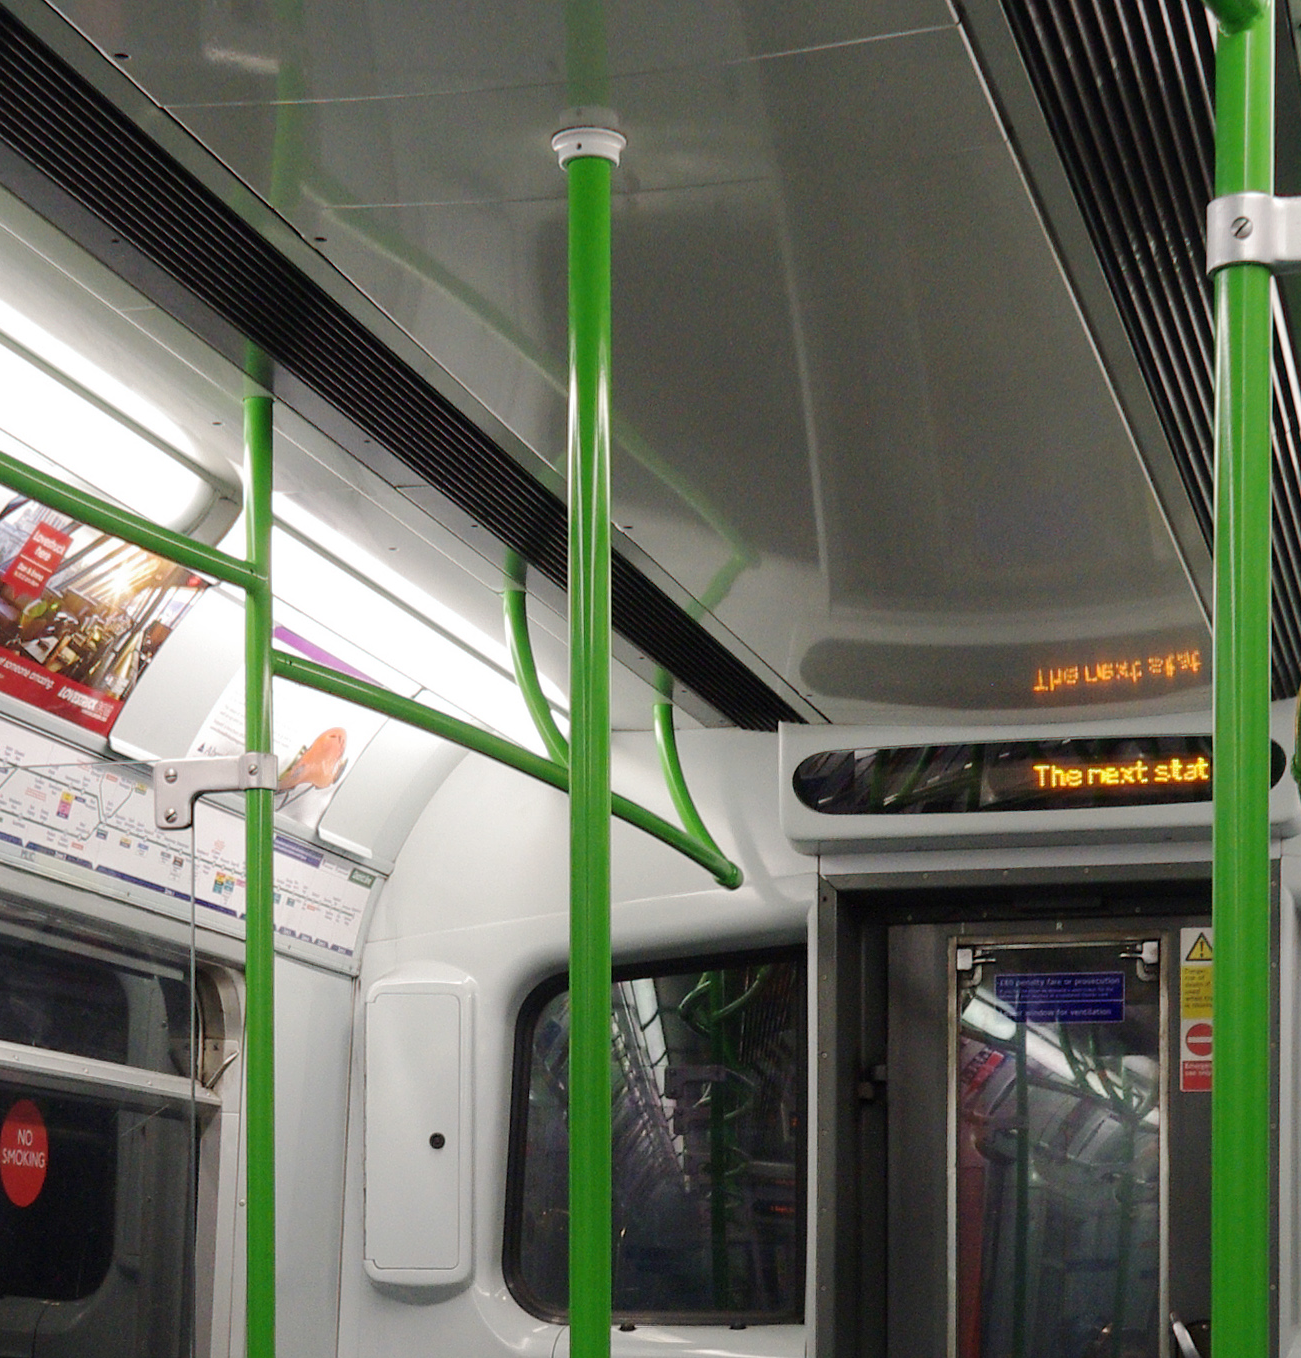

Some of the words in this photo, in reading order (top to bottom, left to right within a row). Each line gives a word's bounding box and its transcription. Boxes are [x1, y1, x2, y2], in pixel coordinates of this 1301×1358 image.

[4, 661, 29, 676] someone
[1033, 764, 1083, 788] The
[1087, 760, 1149, 785] next
[1154, 756, 1209, 783] stat
[1046, 978, 1062, 986] fare
[1074, 977, 1120, 987] prosecution
[17, 1128, 33, 1146] NO
[2, 1147, 45, 1168] SMOKING
